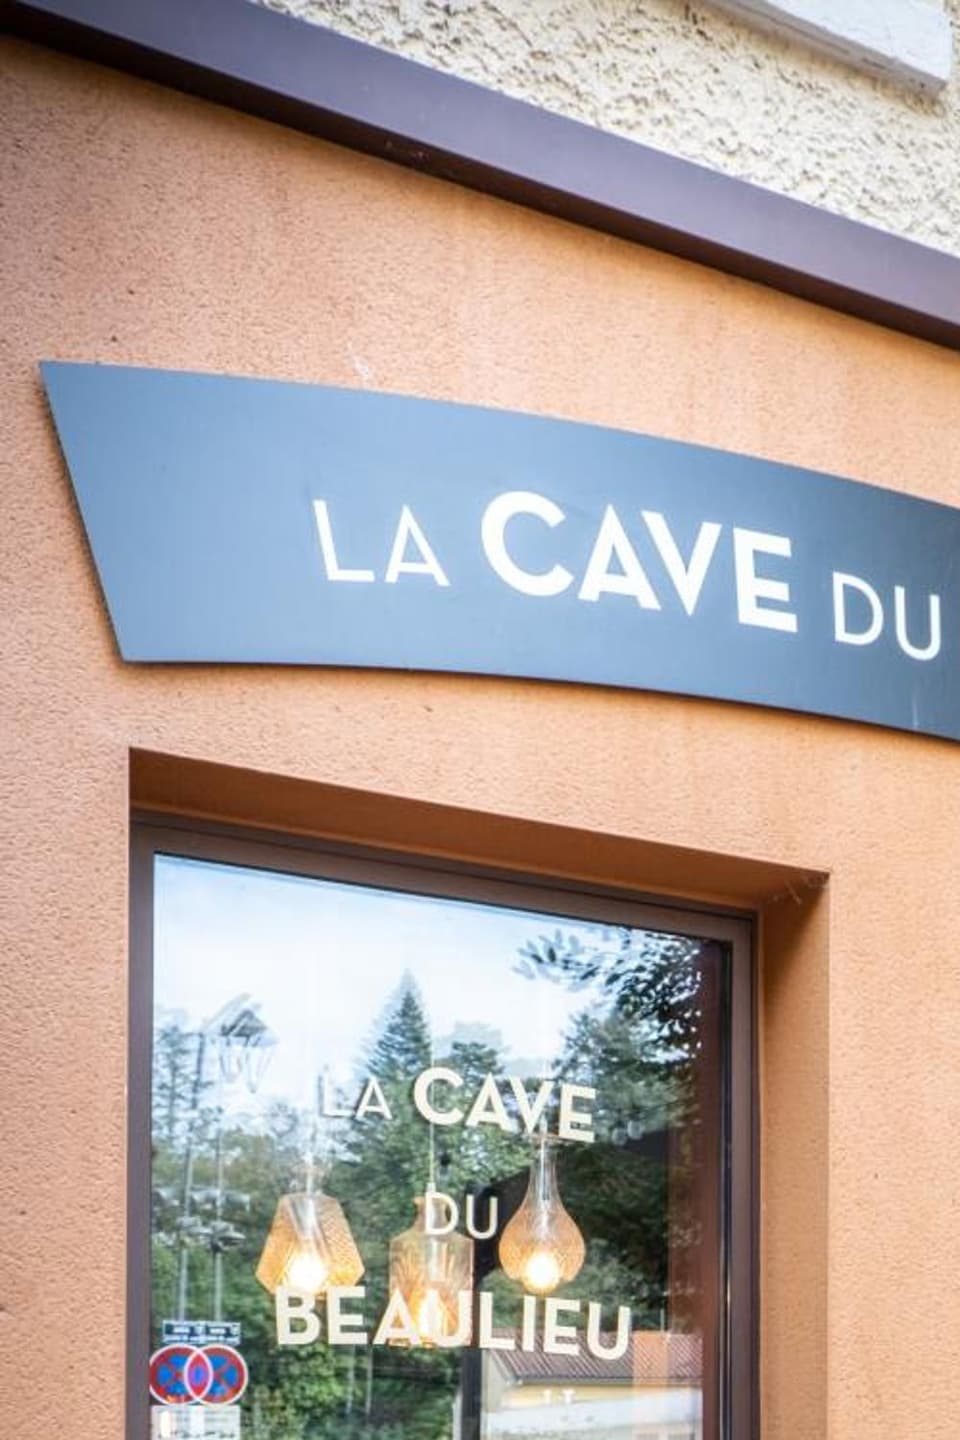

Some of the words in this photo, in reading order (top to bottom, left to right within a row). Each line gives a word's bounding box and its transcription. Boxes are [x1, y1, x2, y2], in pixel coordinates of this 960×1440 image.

[313, 500, 450, 587] LA
[481, 491, 798, 633] CAVE
[832, 571, 942, 661] DU
[318, 1070, 393, 1121] LA
[413, 1067, 597, 1144] CAVE
[423, 1191, 498, 1240] DU
[275, 1285, 631, 1360] BEAULIEU
